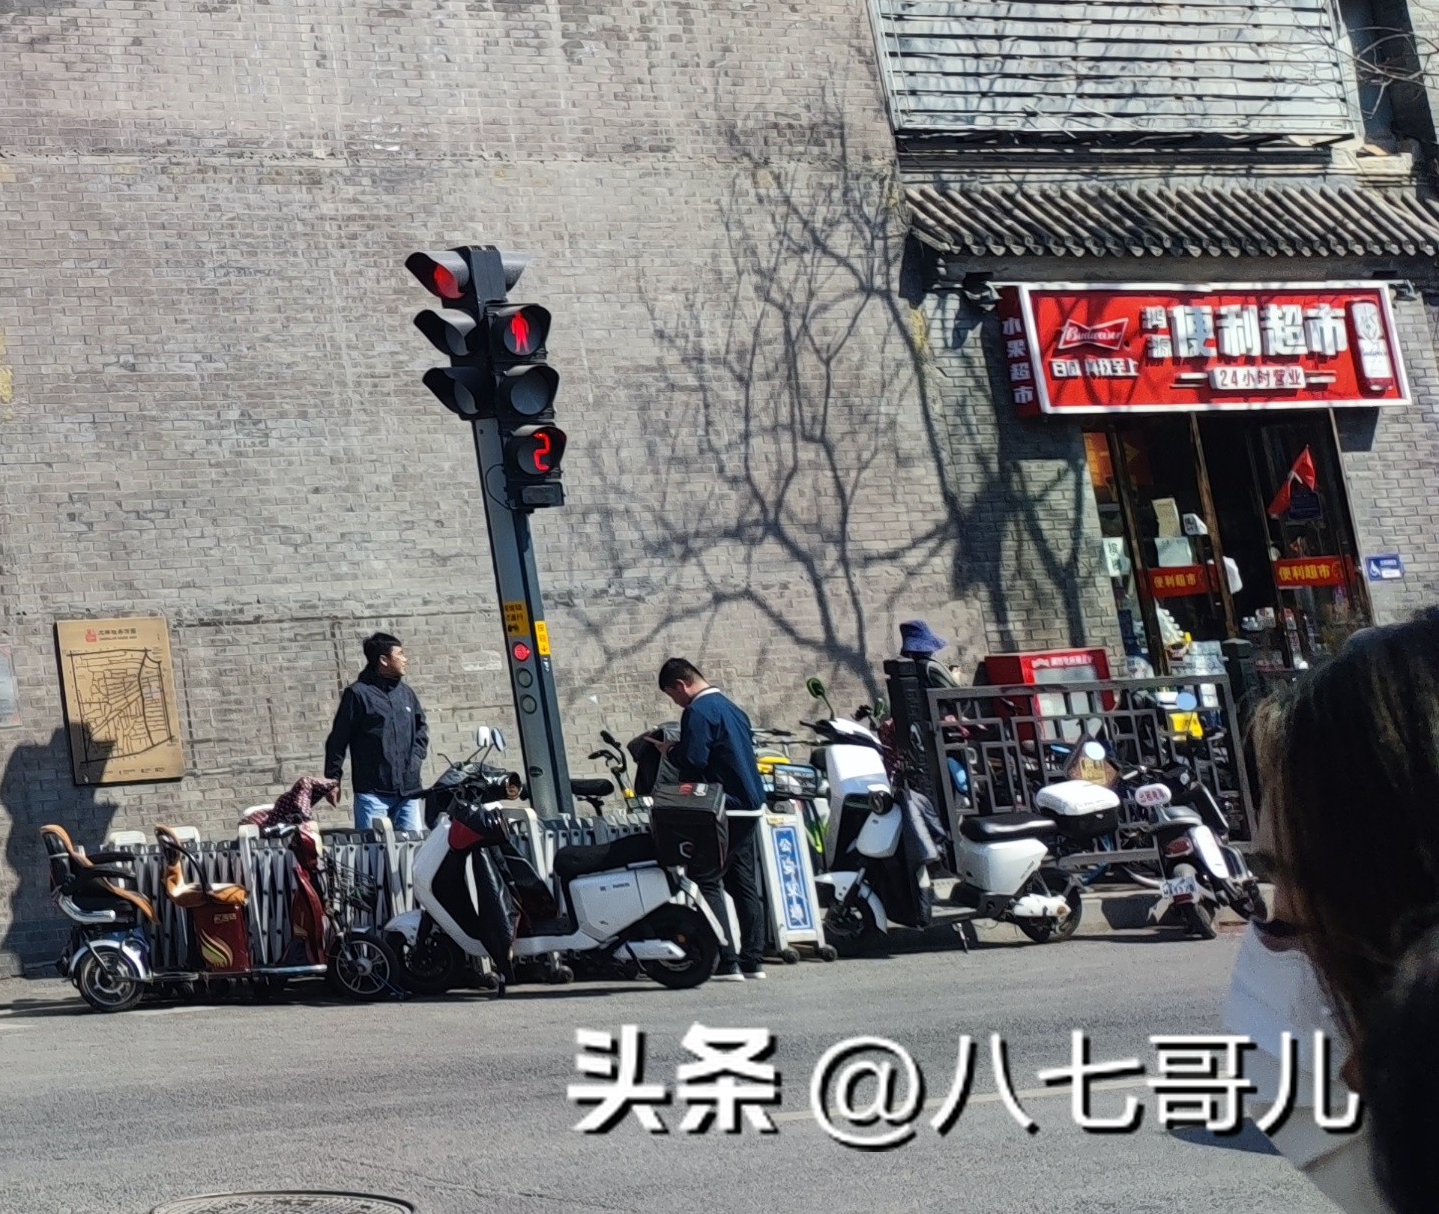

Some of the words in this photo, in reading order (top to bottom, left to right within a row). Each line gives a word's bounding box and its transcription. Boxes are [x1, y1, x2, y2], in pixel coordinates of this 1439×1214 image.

[1169, 304, 1348, 357] 便利超市
[1219, 369, 1303, 388] 24小时营业
[1153, 572, 1197, 589] 便利超市
[1278, 563, 1332, 583] 便利超市
